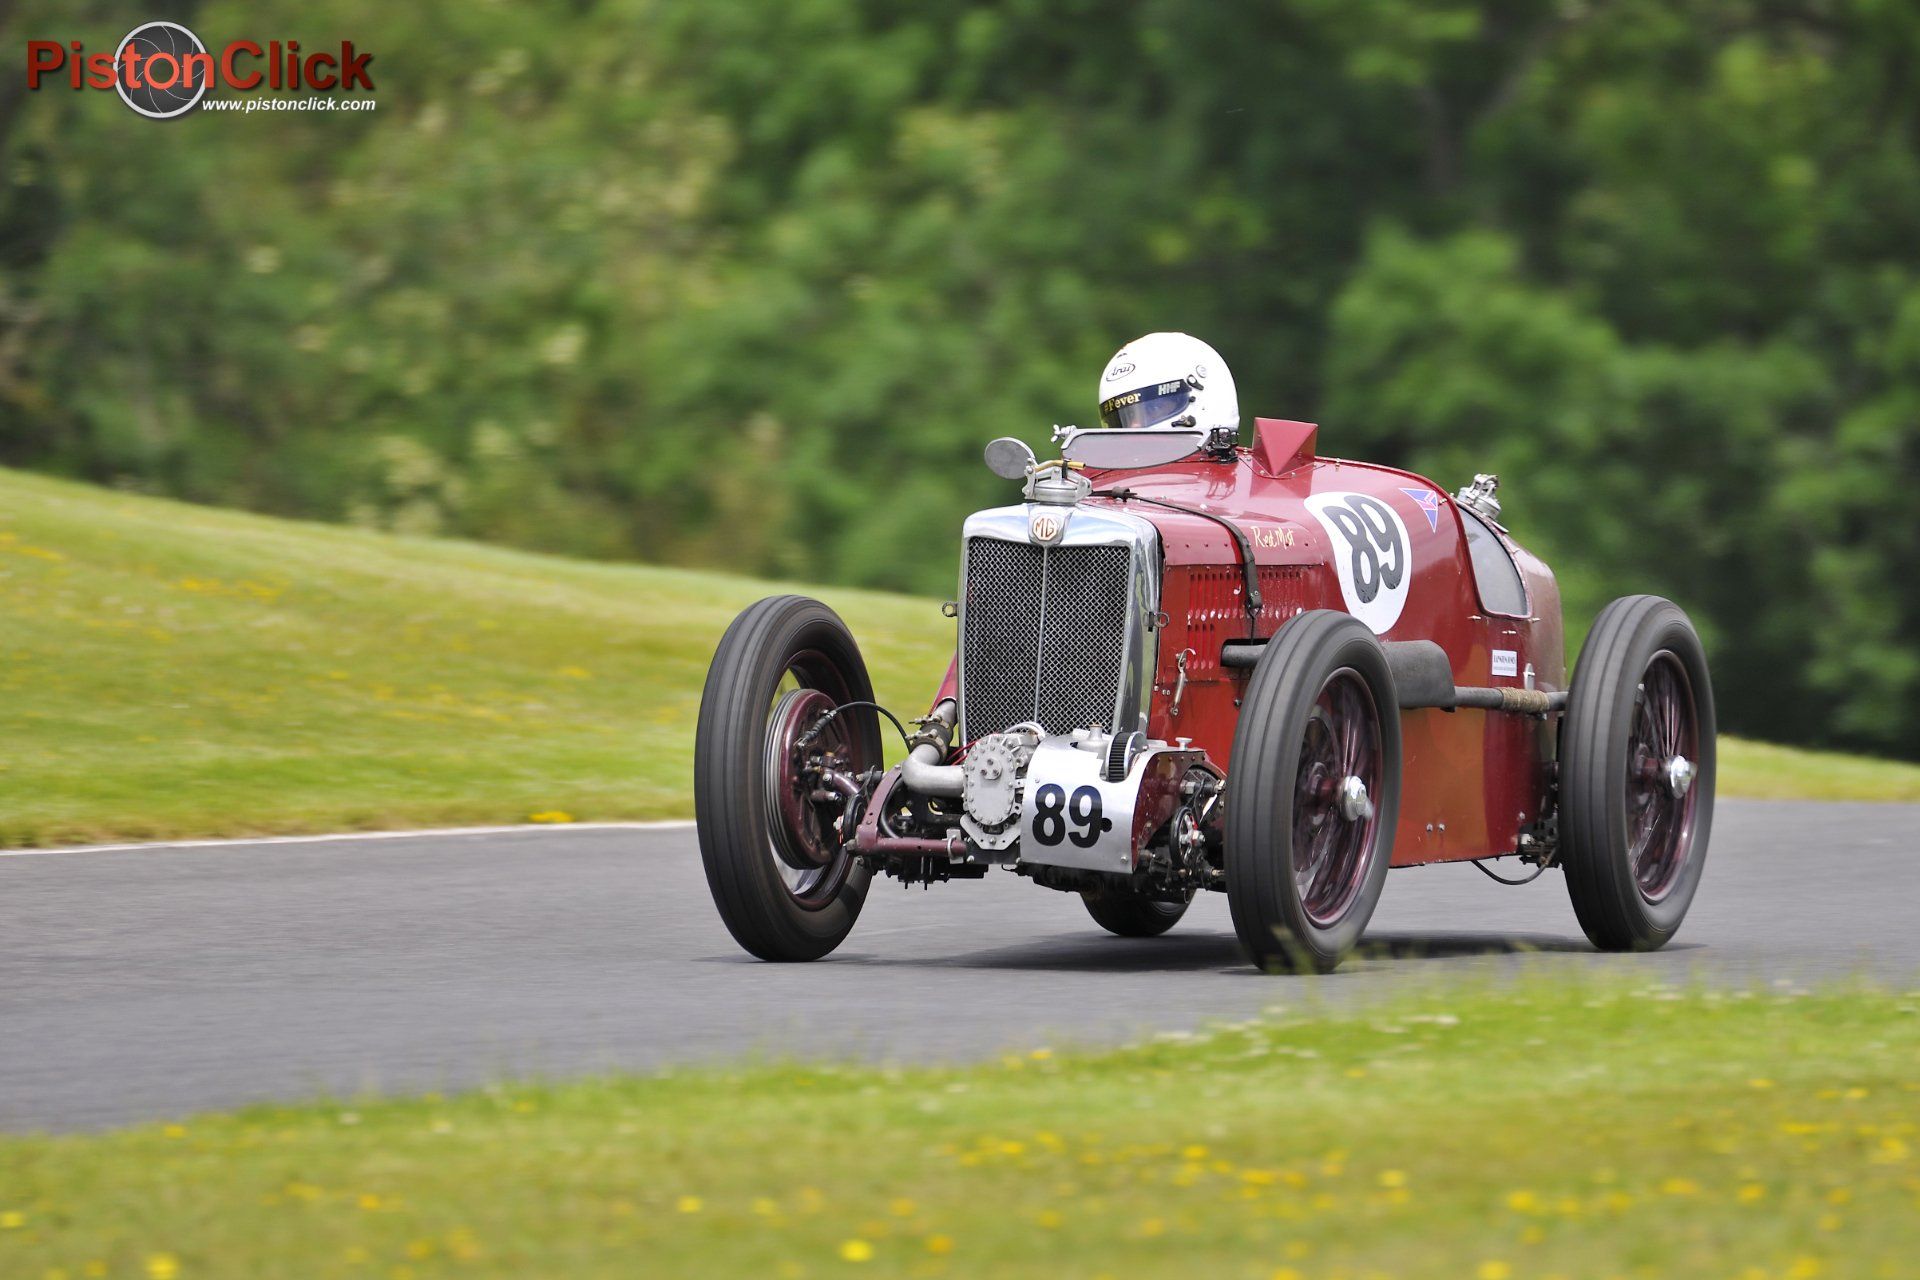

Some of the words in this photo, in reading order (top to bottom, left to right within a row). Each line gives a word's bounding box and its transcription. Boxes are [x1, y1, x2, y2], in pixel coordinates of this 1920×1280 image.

[1035, 517, 1055, 538] MG
[1250, 526, 1277, 548] Red
[1322, 495, 1404, 604] 89
[1032, 783, 1103, 849] 89
